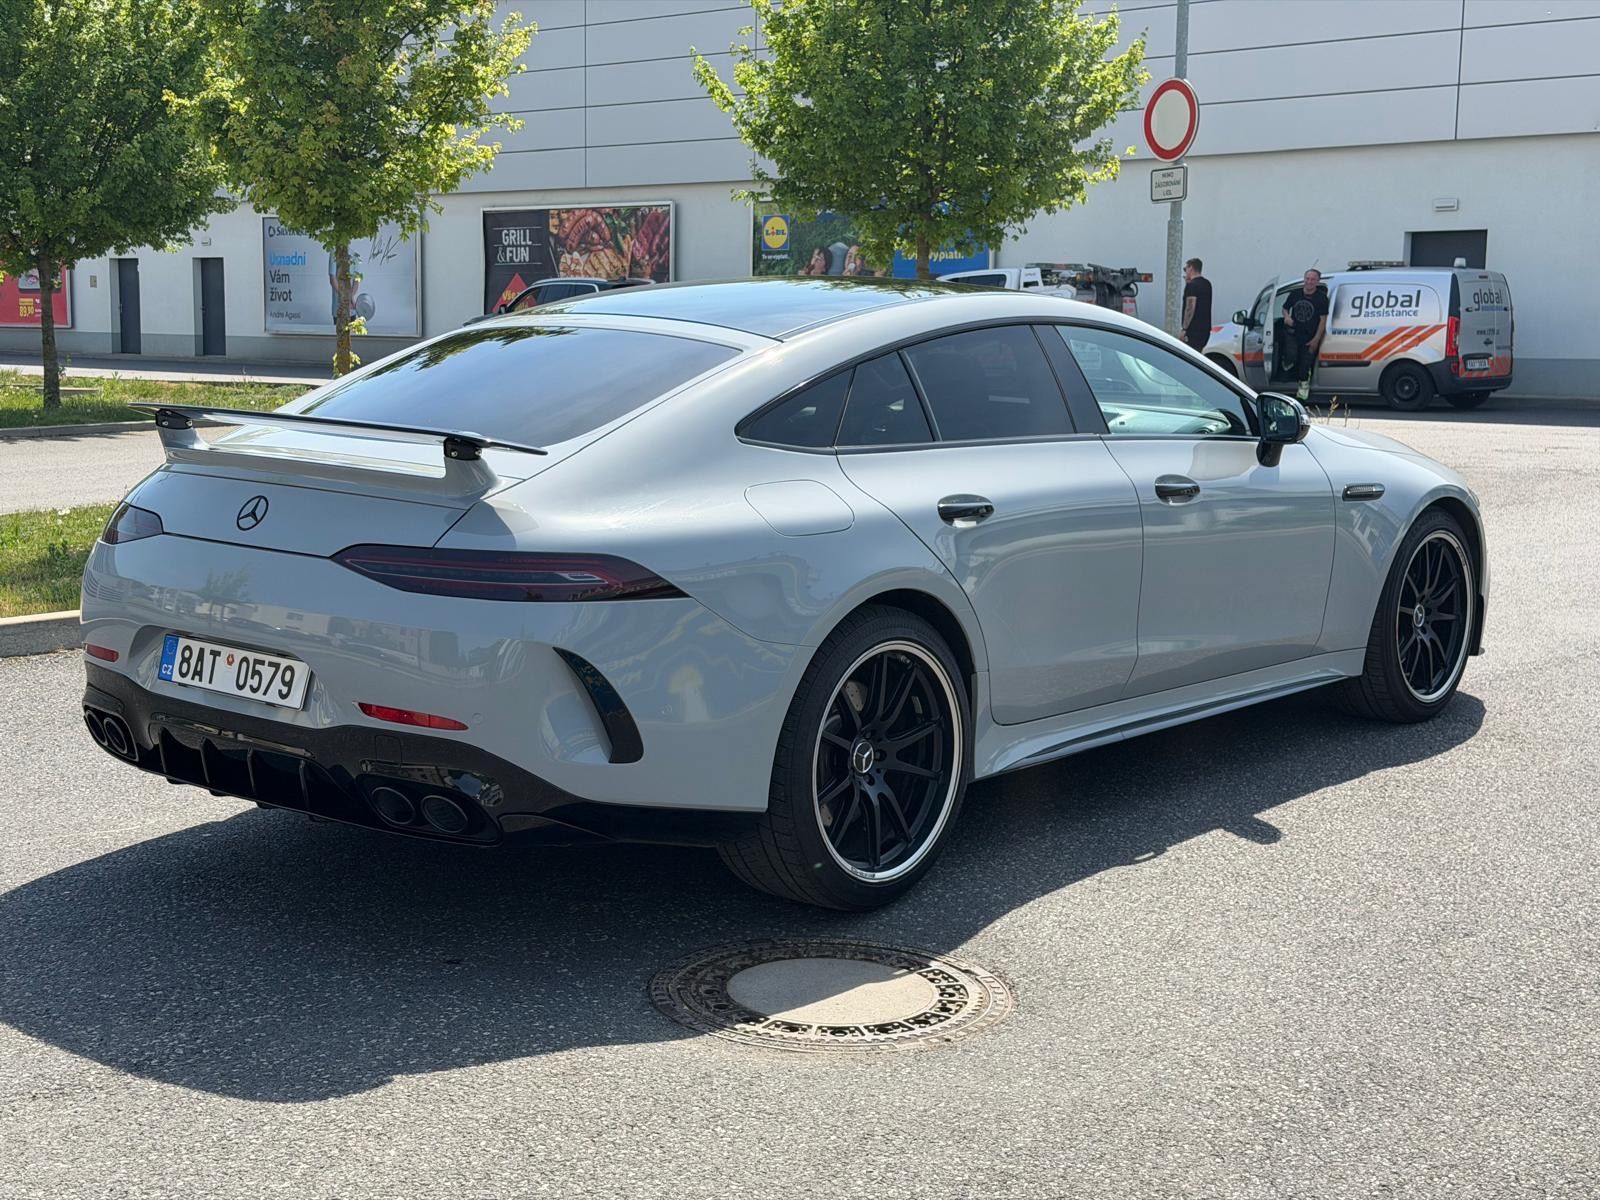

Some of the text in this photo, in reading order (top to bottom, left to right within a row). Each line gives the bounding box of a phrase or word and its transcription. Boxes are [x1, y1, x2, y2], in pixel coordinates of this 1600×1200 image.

[502, 229, 532, 246] GRILL
[269, 269, 290, 284] Vám
[270, 287, 292, 302] život
[1473, 289, 1503, 312] global
[1350, 289, 1421, 318] global
[1363, 308, 1419, 318] assistance
[161, 663, 172, 676] CZ
[178, 645, 296, 700] 8AT 0579
